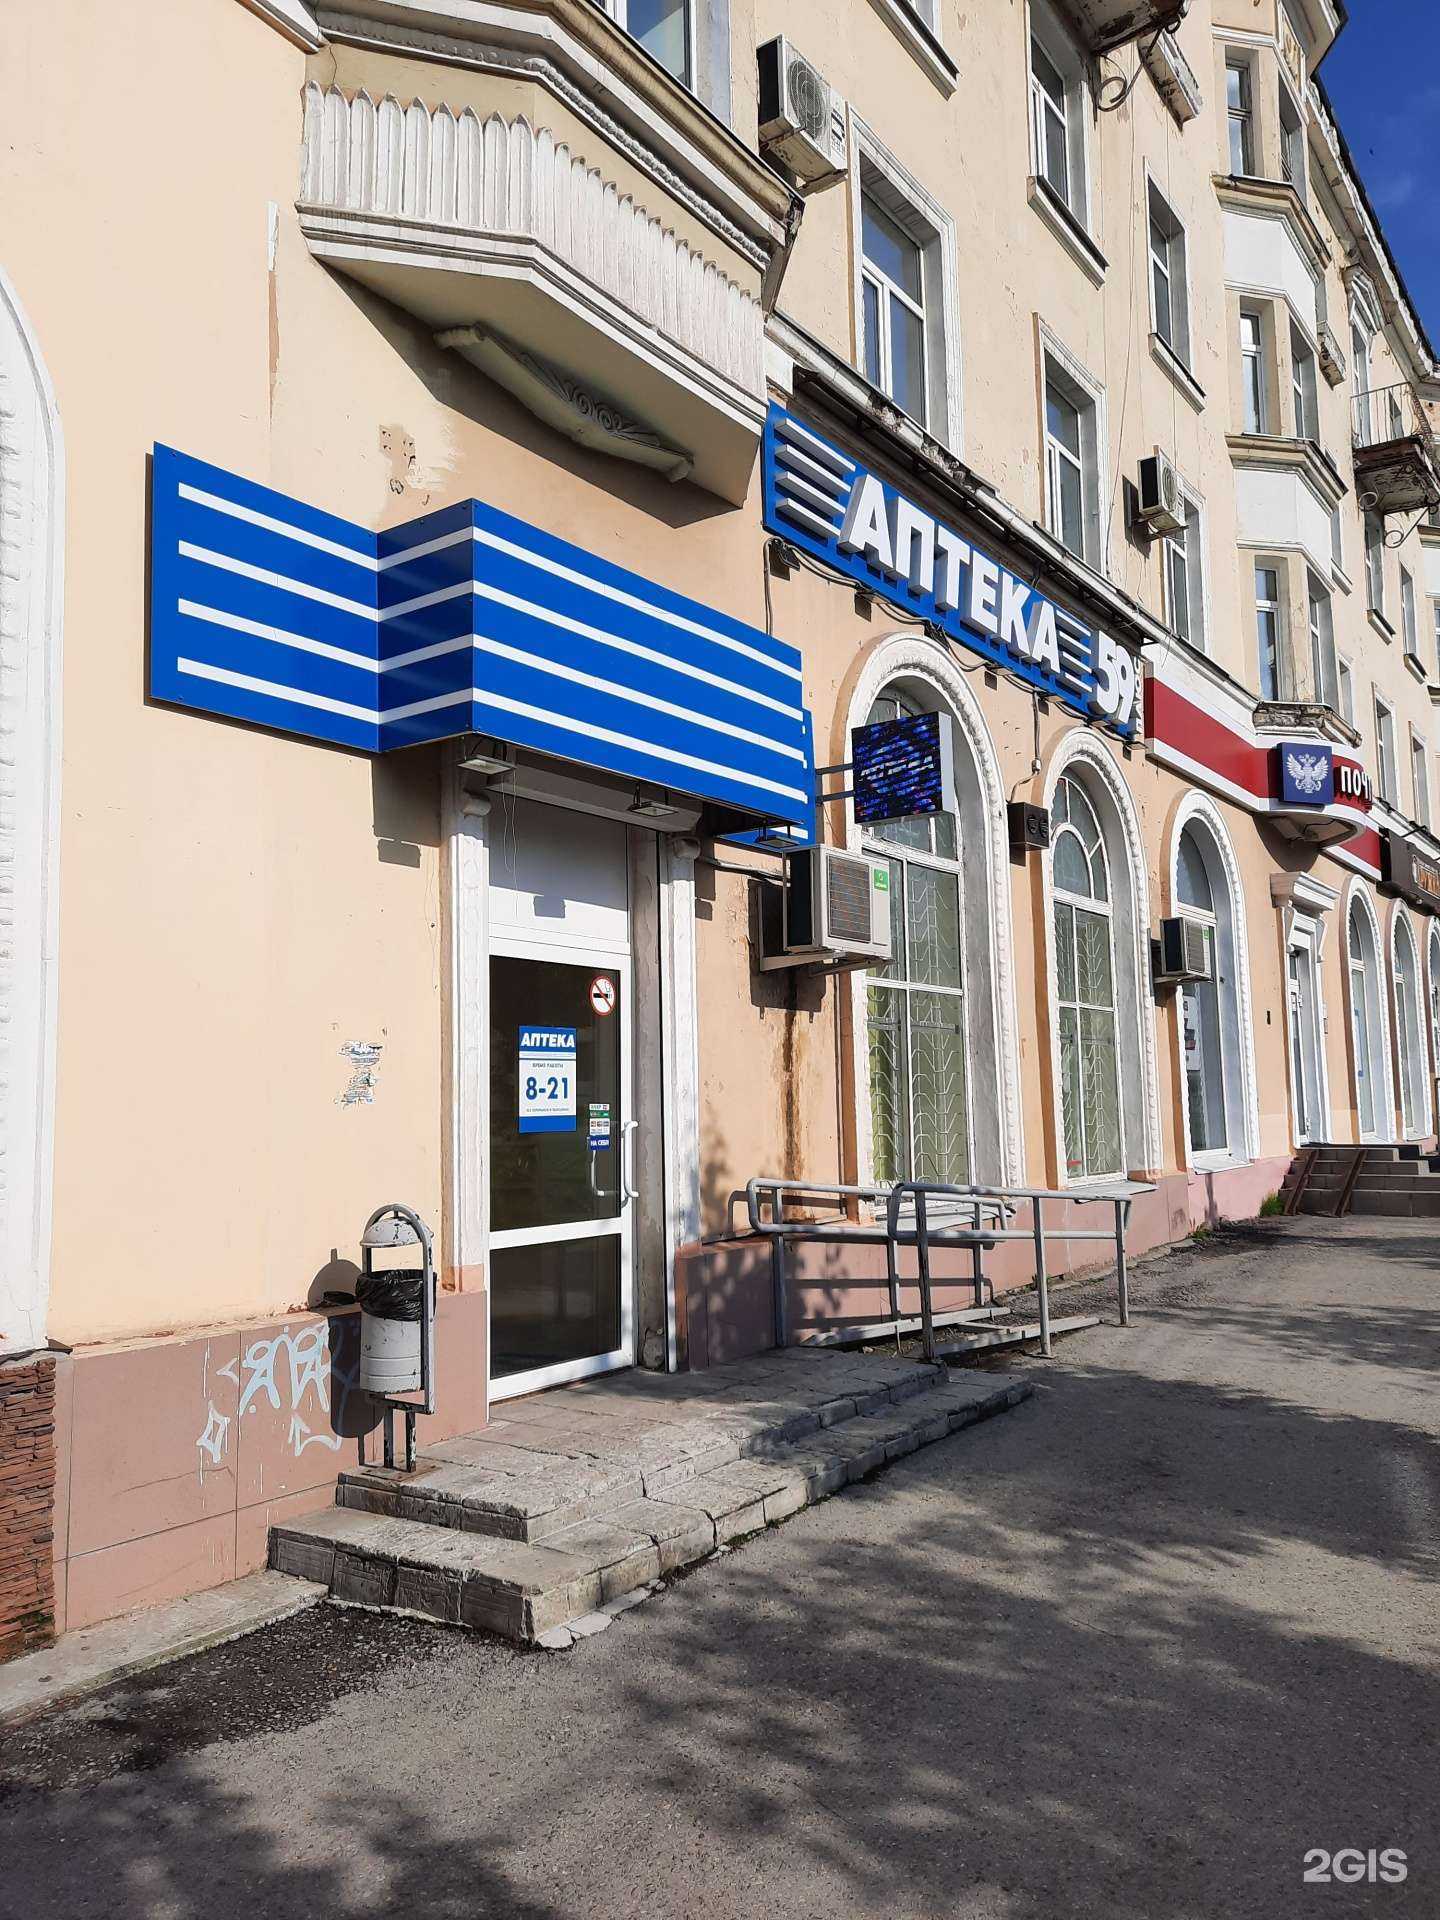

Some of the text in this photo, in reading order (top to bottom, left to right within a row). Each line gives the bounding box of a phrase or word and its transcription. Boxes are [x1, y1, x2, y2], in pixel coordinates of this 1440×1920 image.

[841, 474, 1135, 724] АПТЕКА 59
[520, 1032, 575, 1048] АПТЕКА
[526, 1076, 568, 1100] 8-21
